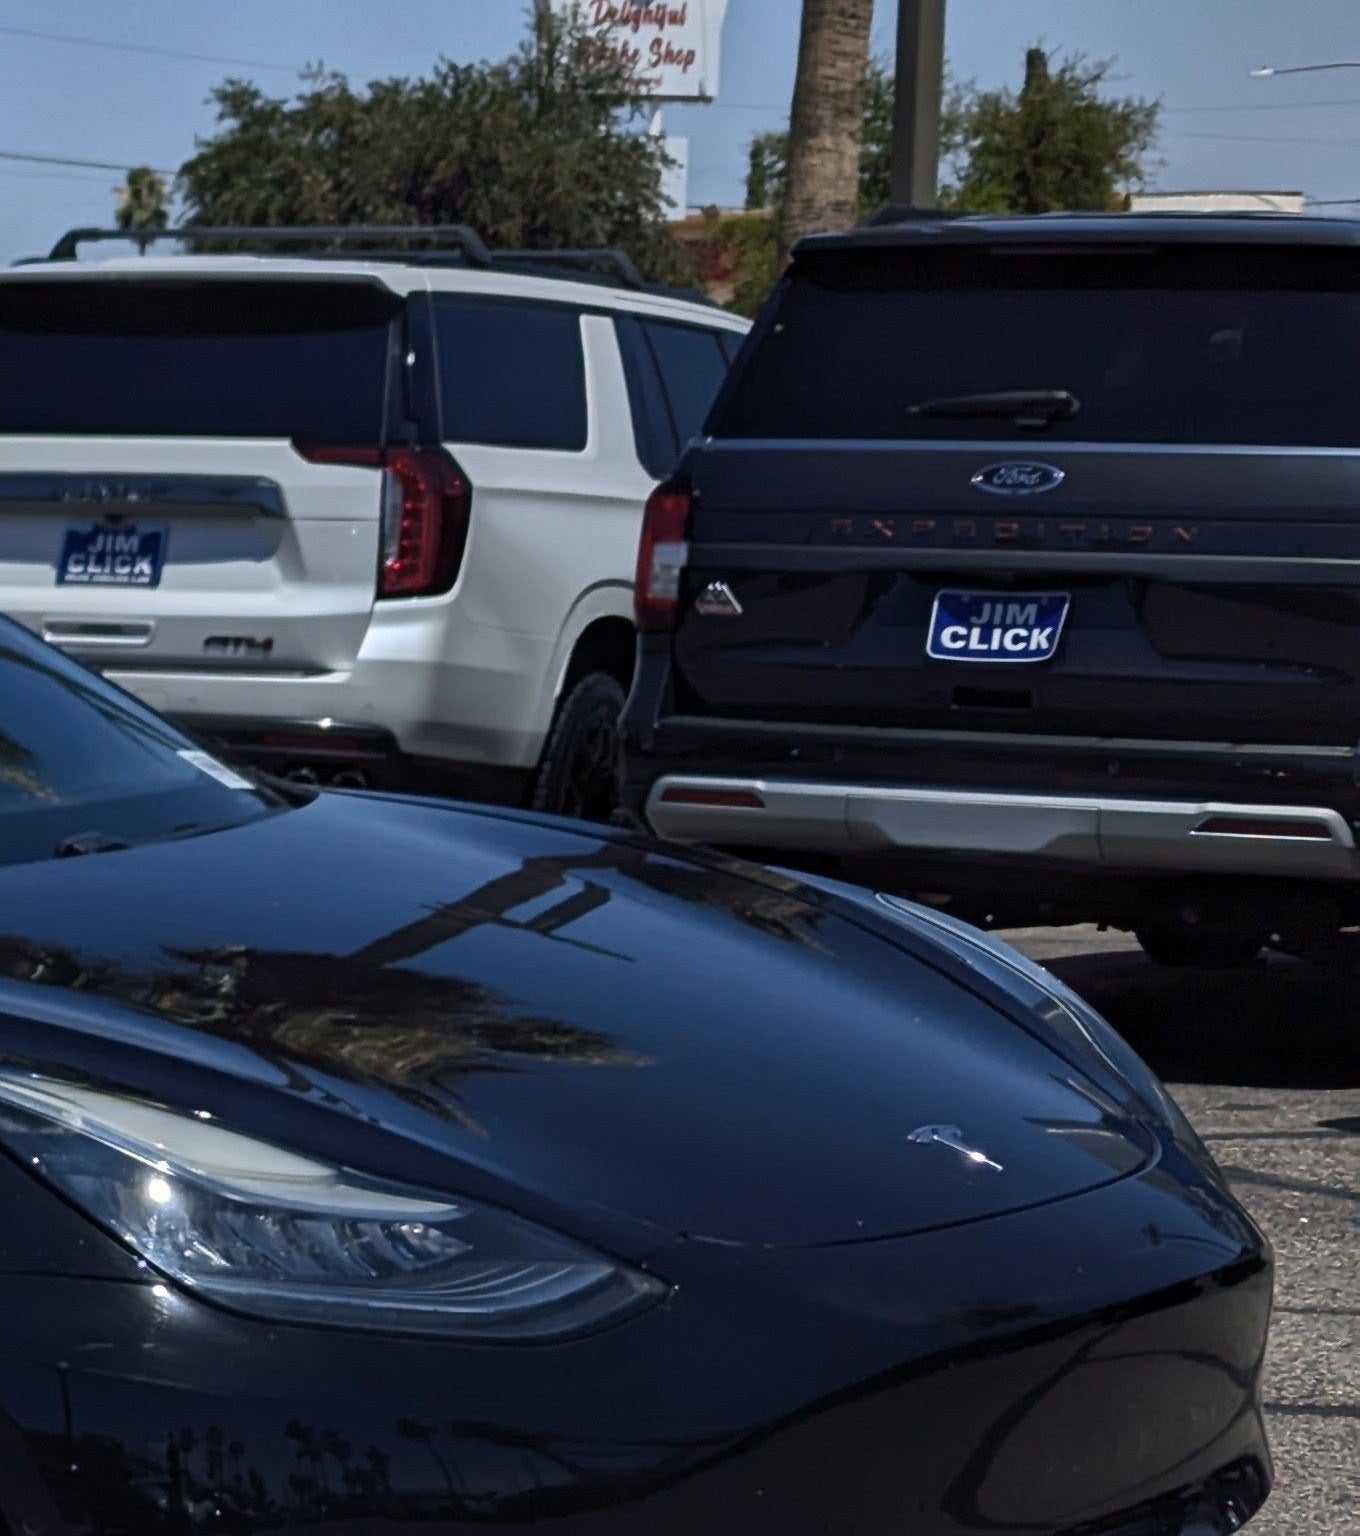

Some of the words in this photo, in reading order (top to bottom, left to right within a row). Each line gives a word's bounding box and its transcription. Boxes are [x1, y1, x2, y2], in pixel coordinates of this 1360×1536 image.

[589, 0, 688, 33] Delightful
[648, 37, 696, 73] Shop
[991, 465, 1043, 486] Ford
[87, 534, 140, 553] JIM
[66, 553, 153, 574] CLICK
[970, 602, 1039, 625] JIM
[940, 625, 1054, 652] CLICK
